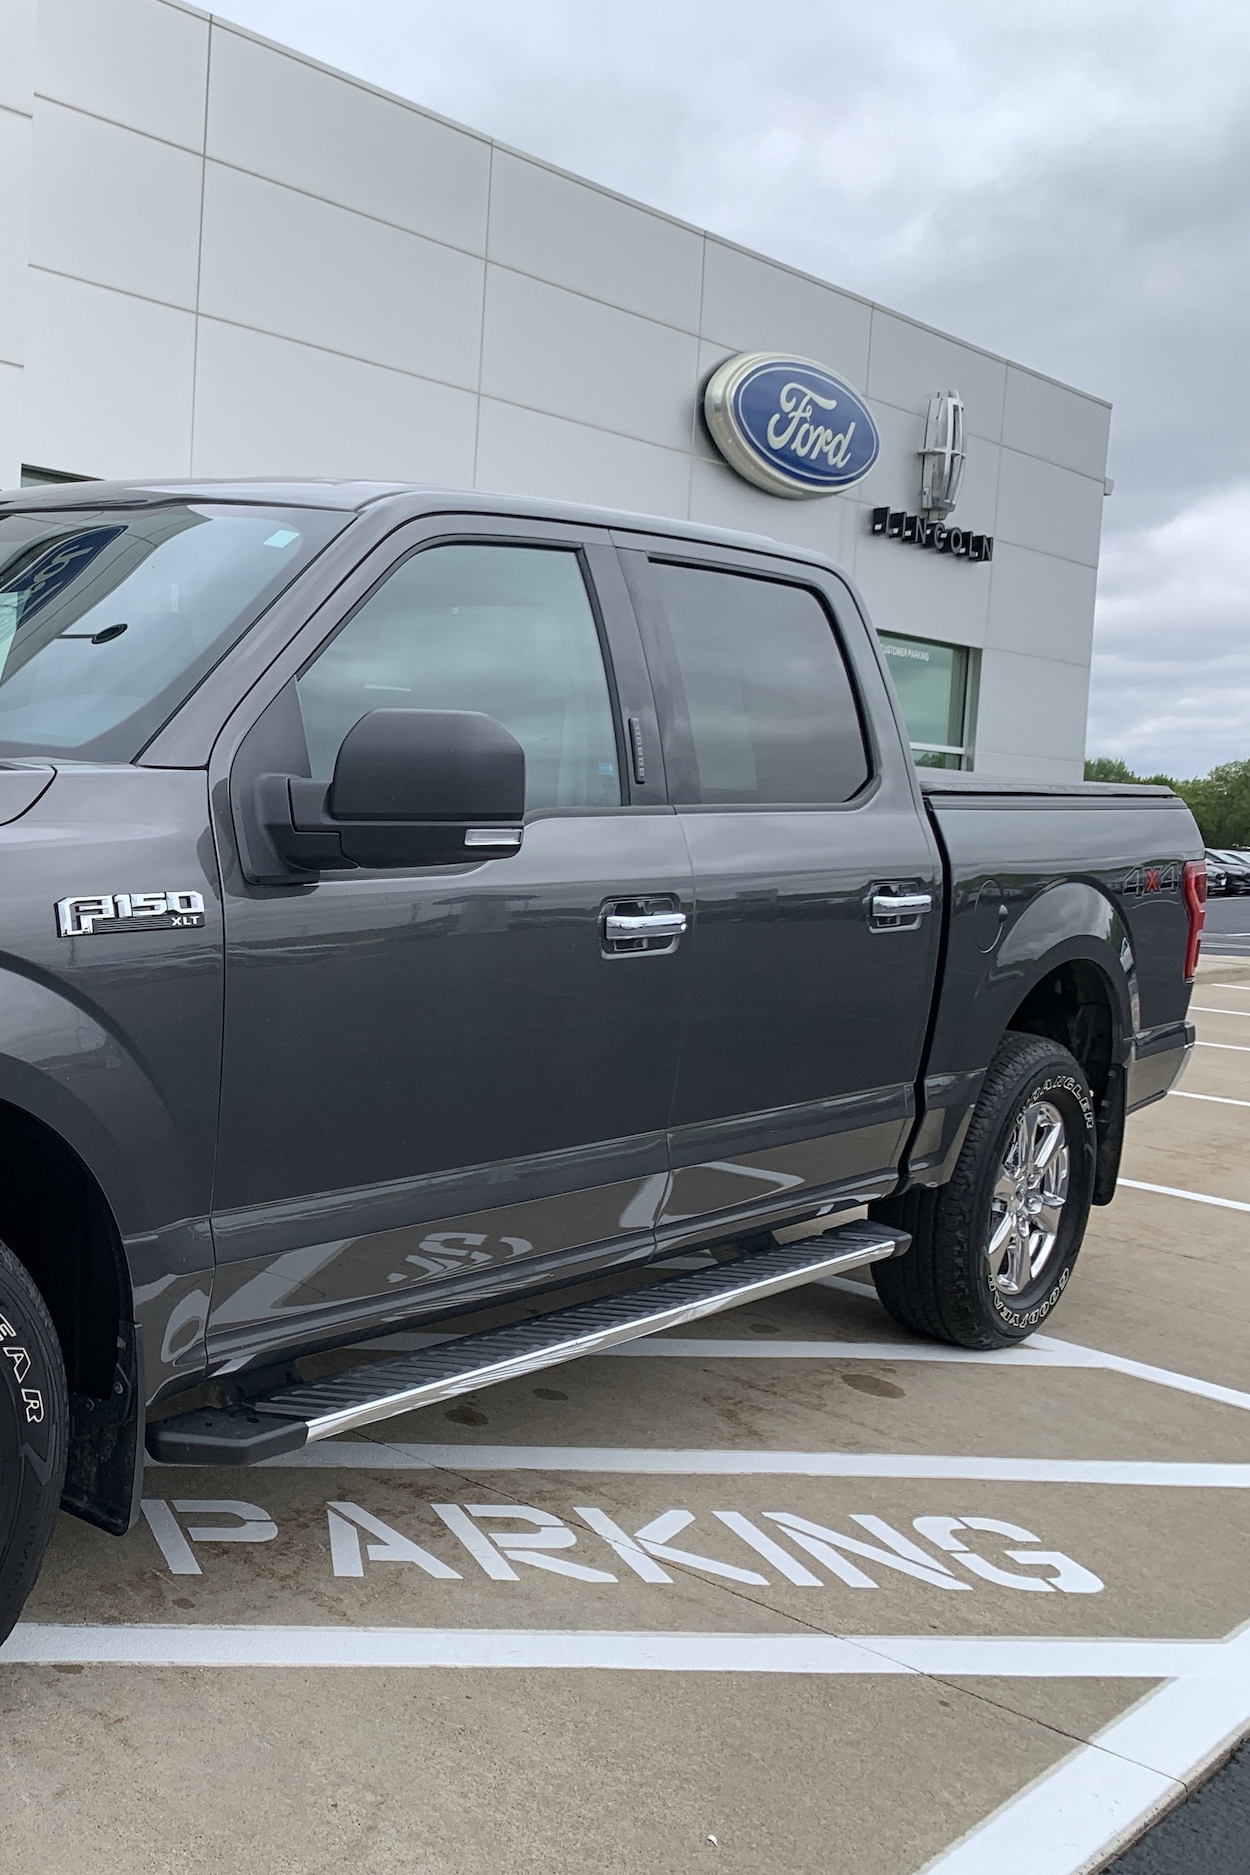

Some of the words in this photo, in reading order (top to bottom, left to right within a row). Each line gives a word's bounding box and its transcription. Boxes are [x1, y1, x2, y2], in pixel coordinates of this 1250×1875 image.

[767, 382, 856, 469] Ford
[171, 916, 200, 927] XLT
[139, 1498, 1106, 1596] PARKING
